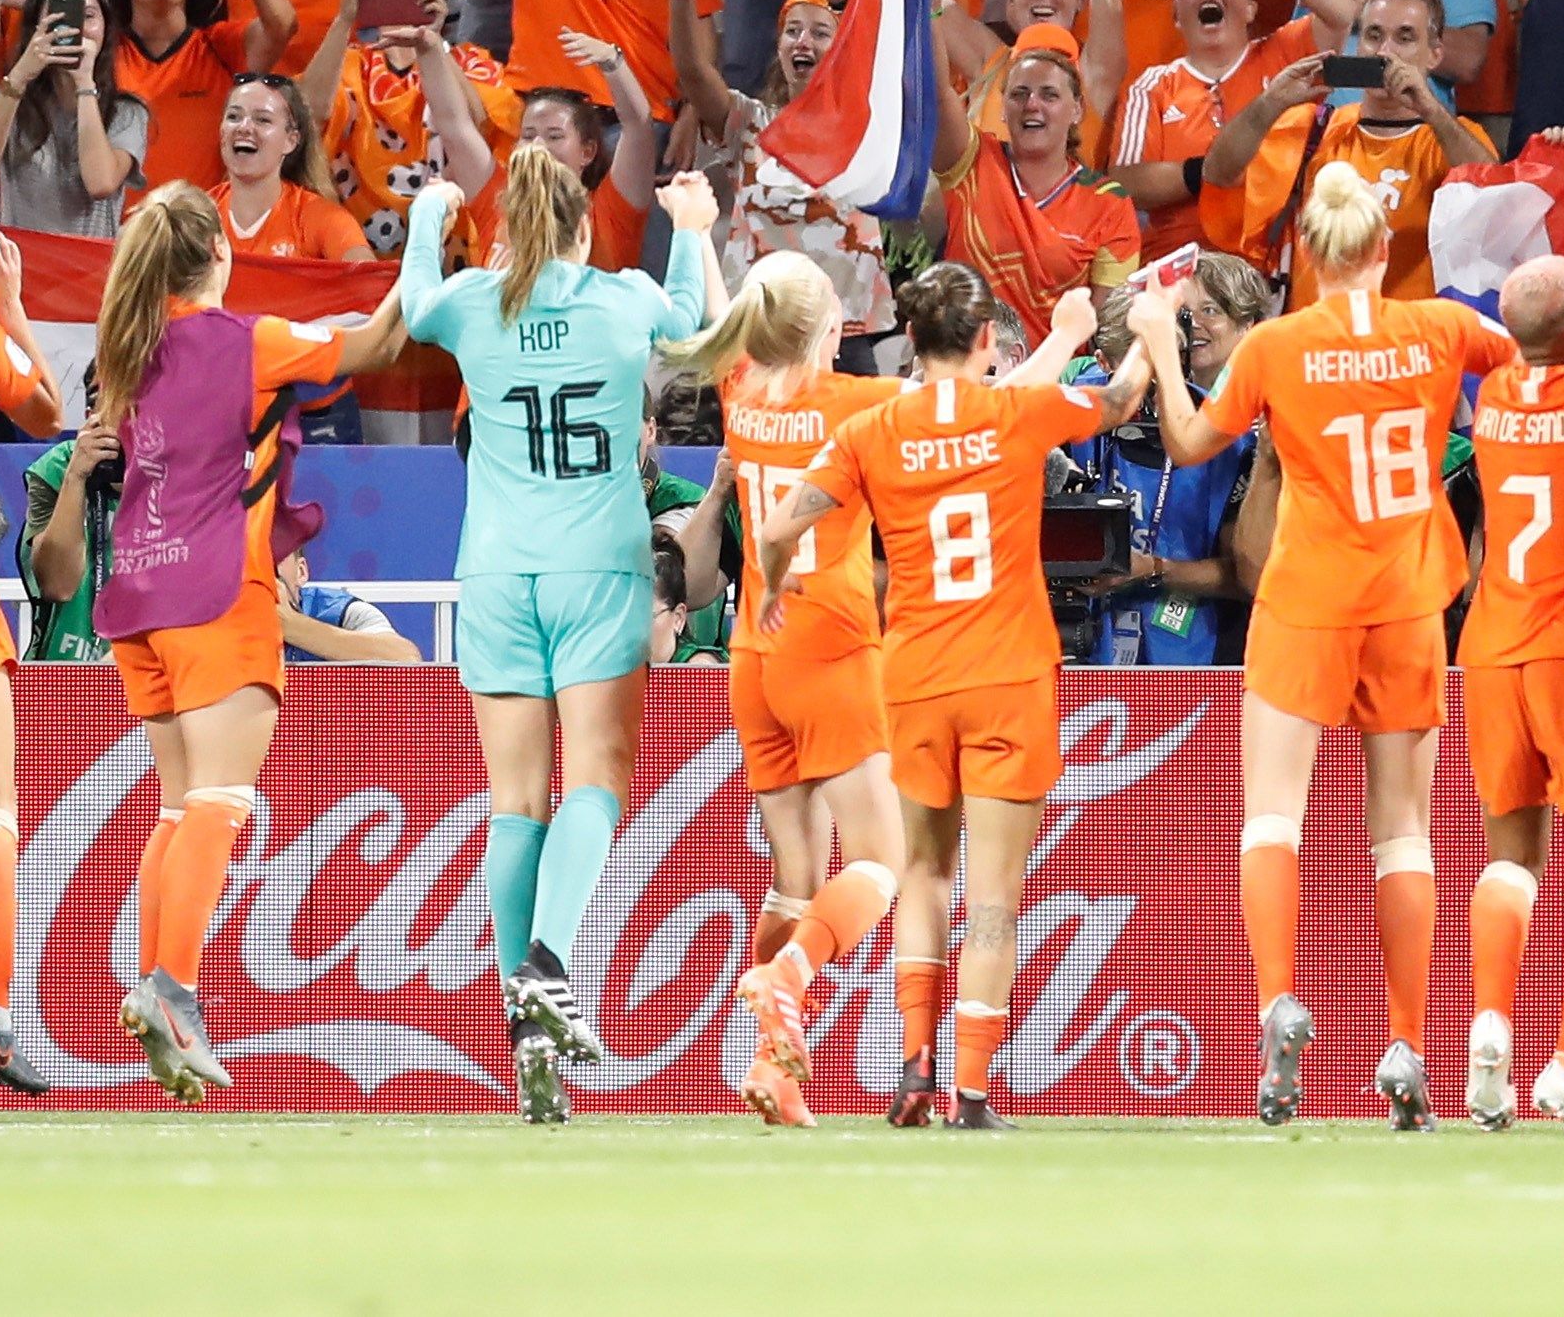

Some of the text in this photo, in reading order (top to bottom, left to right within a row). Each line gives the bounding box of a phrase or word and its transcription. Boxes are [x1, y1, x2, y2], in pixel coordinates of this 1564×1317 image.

[518, 319, 570, 354] KOP
[1304, 340, 1432, 385] KERKDIJK
[501, 380, 612, 481] 16
[727, 402, 825, 443] KAAGMAN
[1499, 410, 1526, 443] DE
[900, 428, 1001, 473] SPITSE
[1321, 406, 1433, 523] 18
[929, 492, 993, 602] 8
[1499, 474, 1552, 583] 7
[1166, 602, 1185, 617] 50
